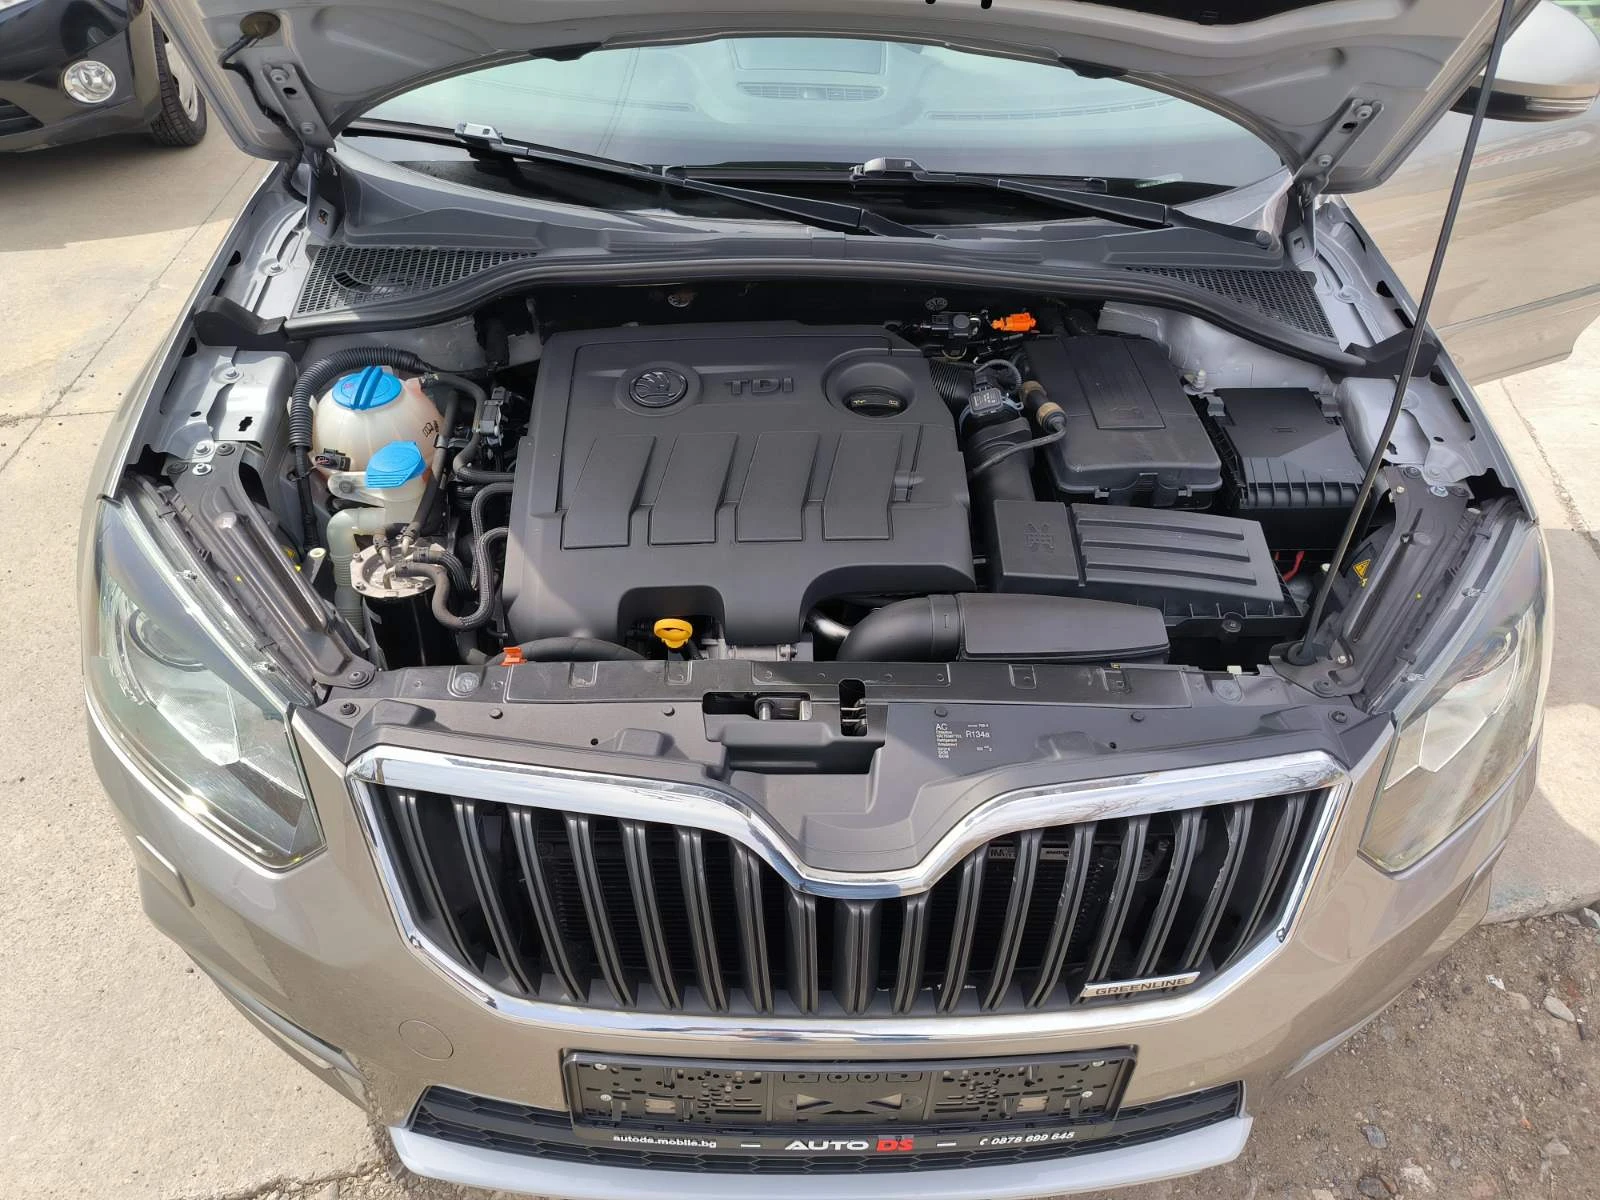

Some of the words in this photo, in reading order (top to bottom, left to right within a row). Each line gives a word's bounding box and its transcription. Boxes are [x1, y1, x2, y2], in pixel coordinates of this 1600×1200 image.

[725, 377, 794, 396] TDI
[935, 722, 948, 731] AC
[965, 730, 990, 738] R134a
[1095, 978, 1186, 996] GREENLINE
[785, 1139, 869, 1151] AUTO
[876, 1138, 914, 1152] DS
[991, 1136, 1022, 1145] 0878
[1025, 1134, 1048, 1143] 699
